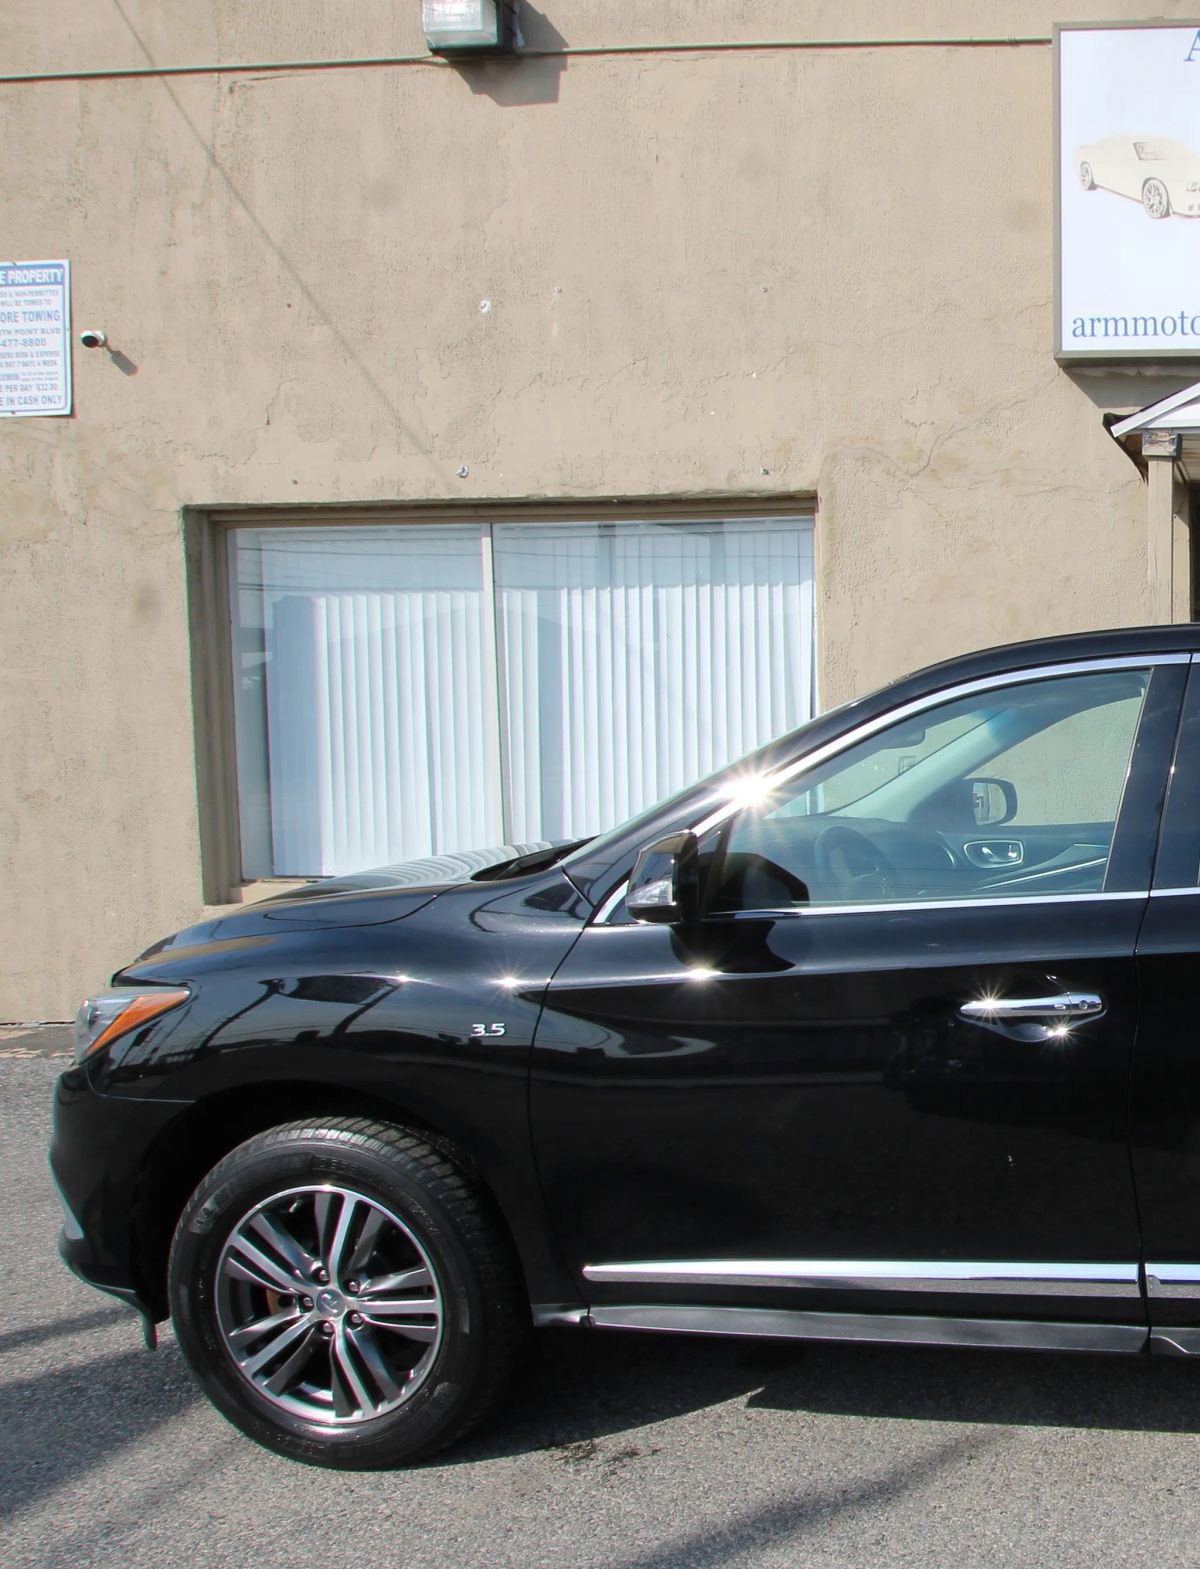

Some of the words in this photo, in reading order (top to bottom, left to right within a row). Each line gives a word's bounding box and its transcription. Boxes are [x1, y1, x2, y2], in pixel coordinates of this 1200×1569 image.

[8, 268, 63, 284] PROPERTY
[22, 310, 60, 322] TOWING
[41, 327, 61, 335] BLVD
[17, 395, 39, 405] CASH
[41, 395, 62, 405] ONLY
